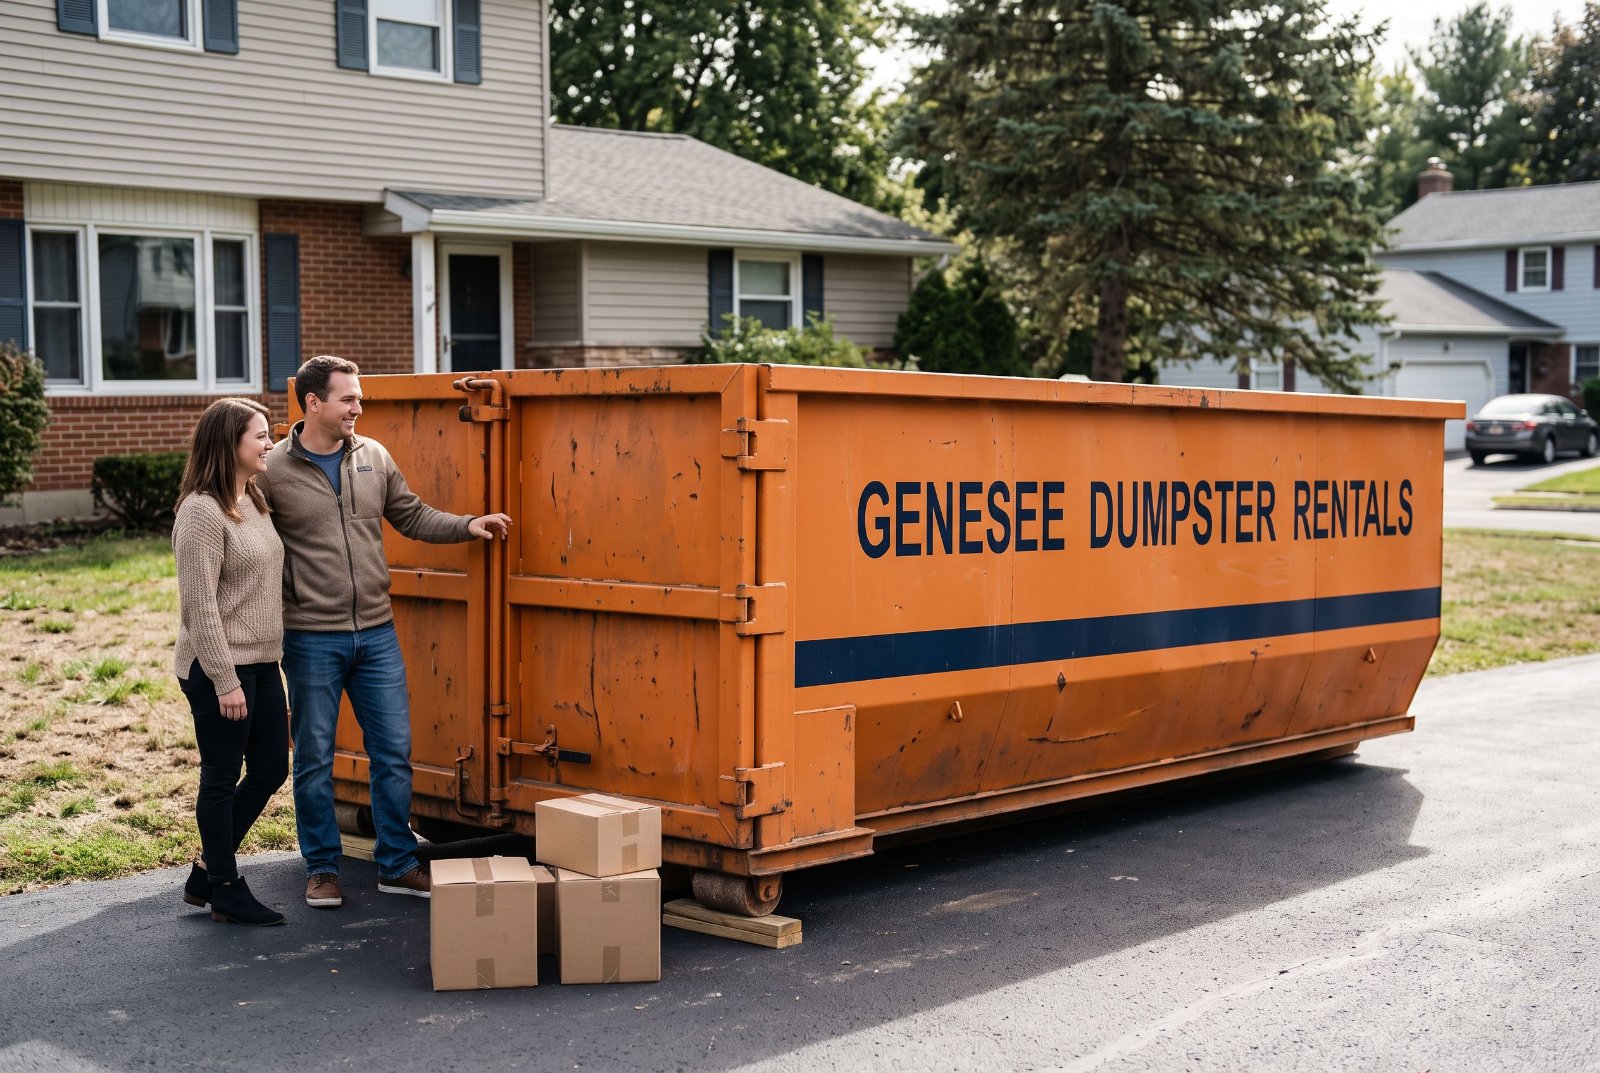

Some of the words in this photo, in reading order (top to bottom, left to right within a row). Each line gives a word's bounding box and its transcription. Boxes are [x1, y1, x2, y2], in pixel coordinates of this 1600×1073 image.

[858, 481, 1065, 559] GENESEE
[1090, 481, 1276, 549] DUMPSTER
[1294, 479, 1413, 540] RENTALS
